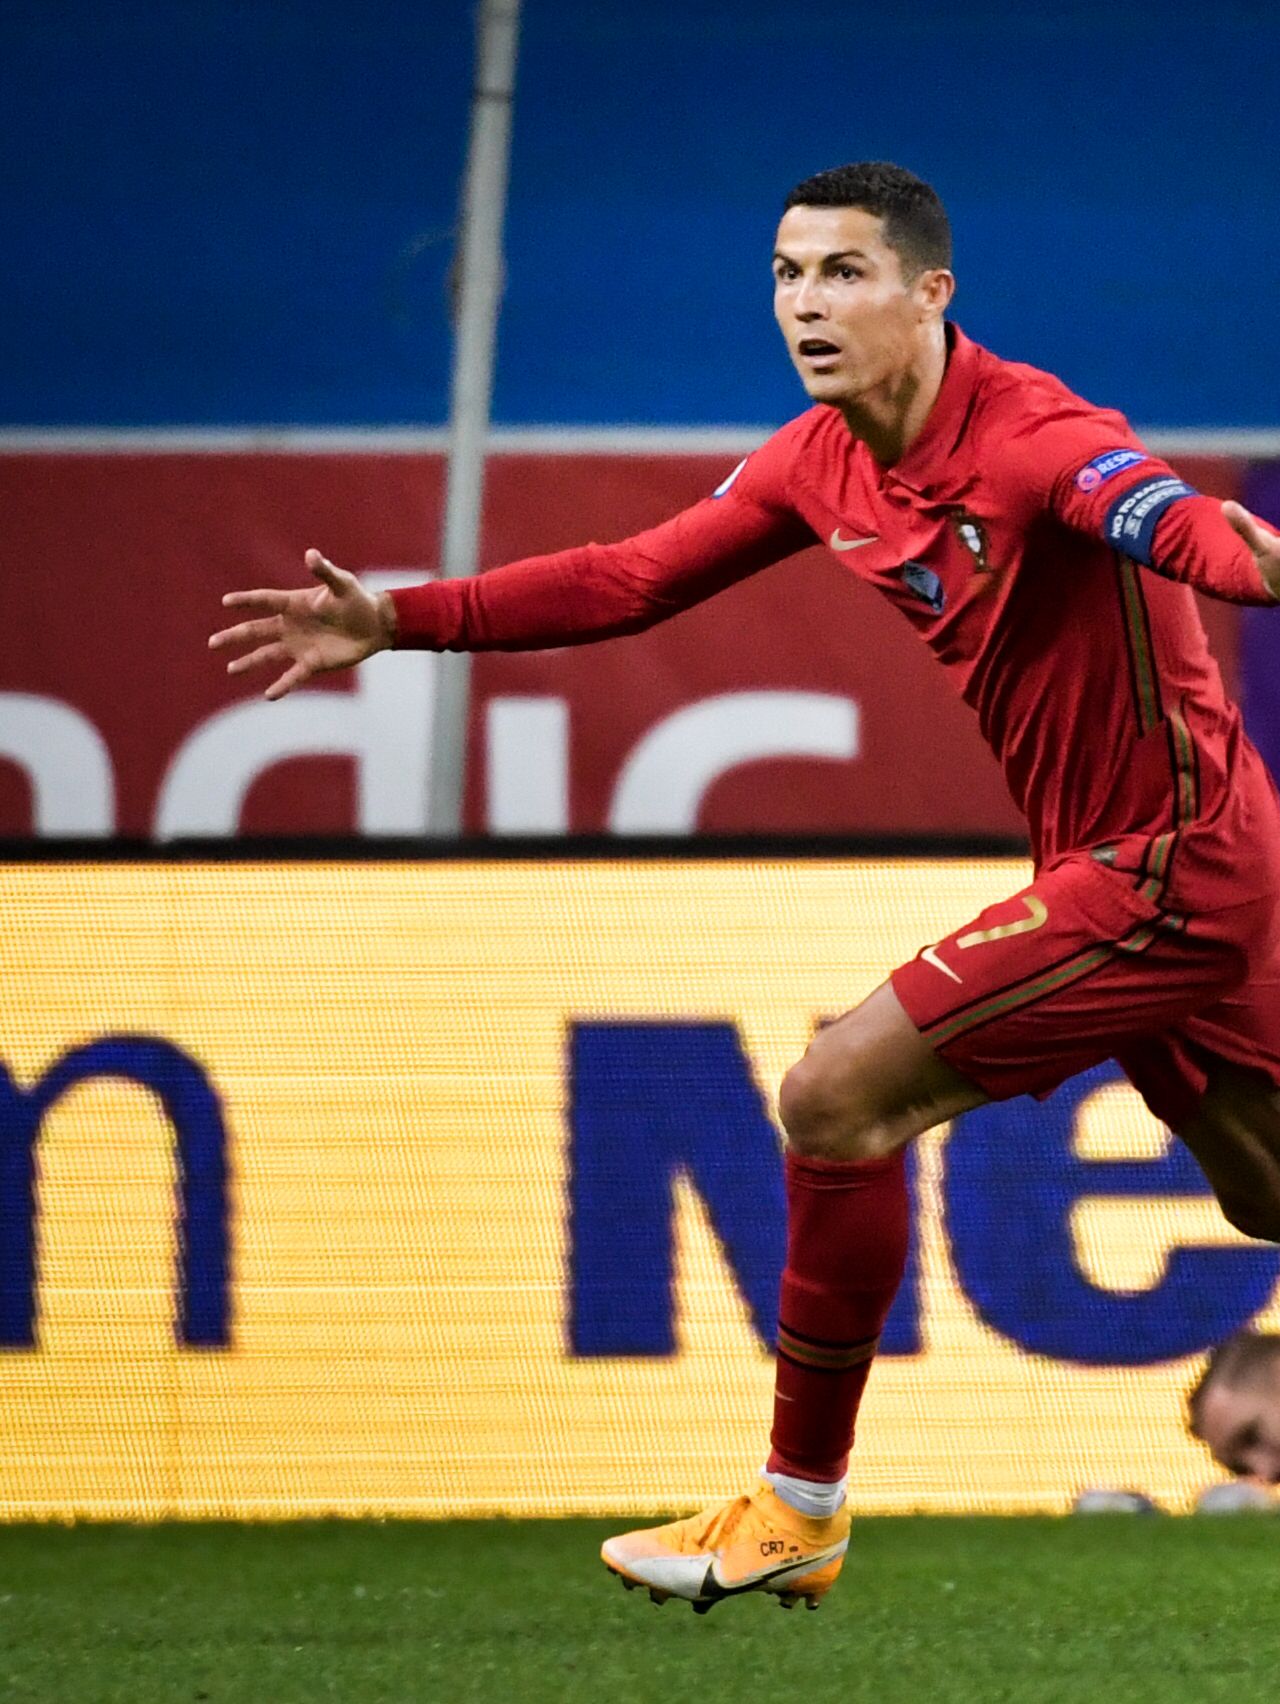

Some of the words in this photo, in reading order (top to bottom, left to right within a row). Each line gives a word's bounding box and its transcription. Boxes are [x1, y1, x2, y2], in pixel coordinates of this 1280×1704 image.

[1111, 514, 1124, 538] NO
[956, 895, 1048, 949] 7
[760, 1540, 784, 1557] CR7
